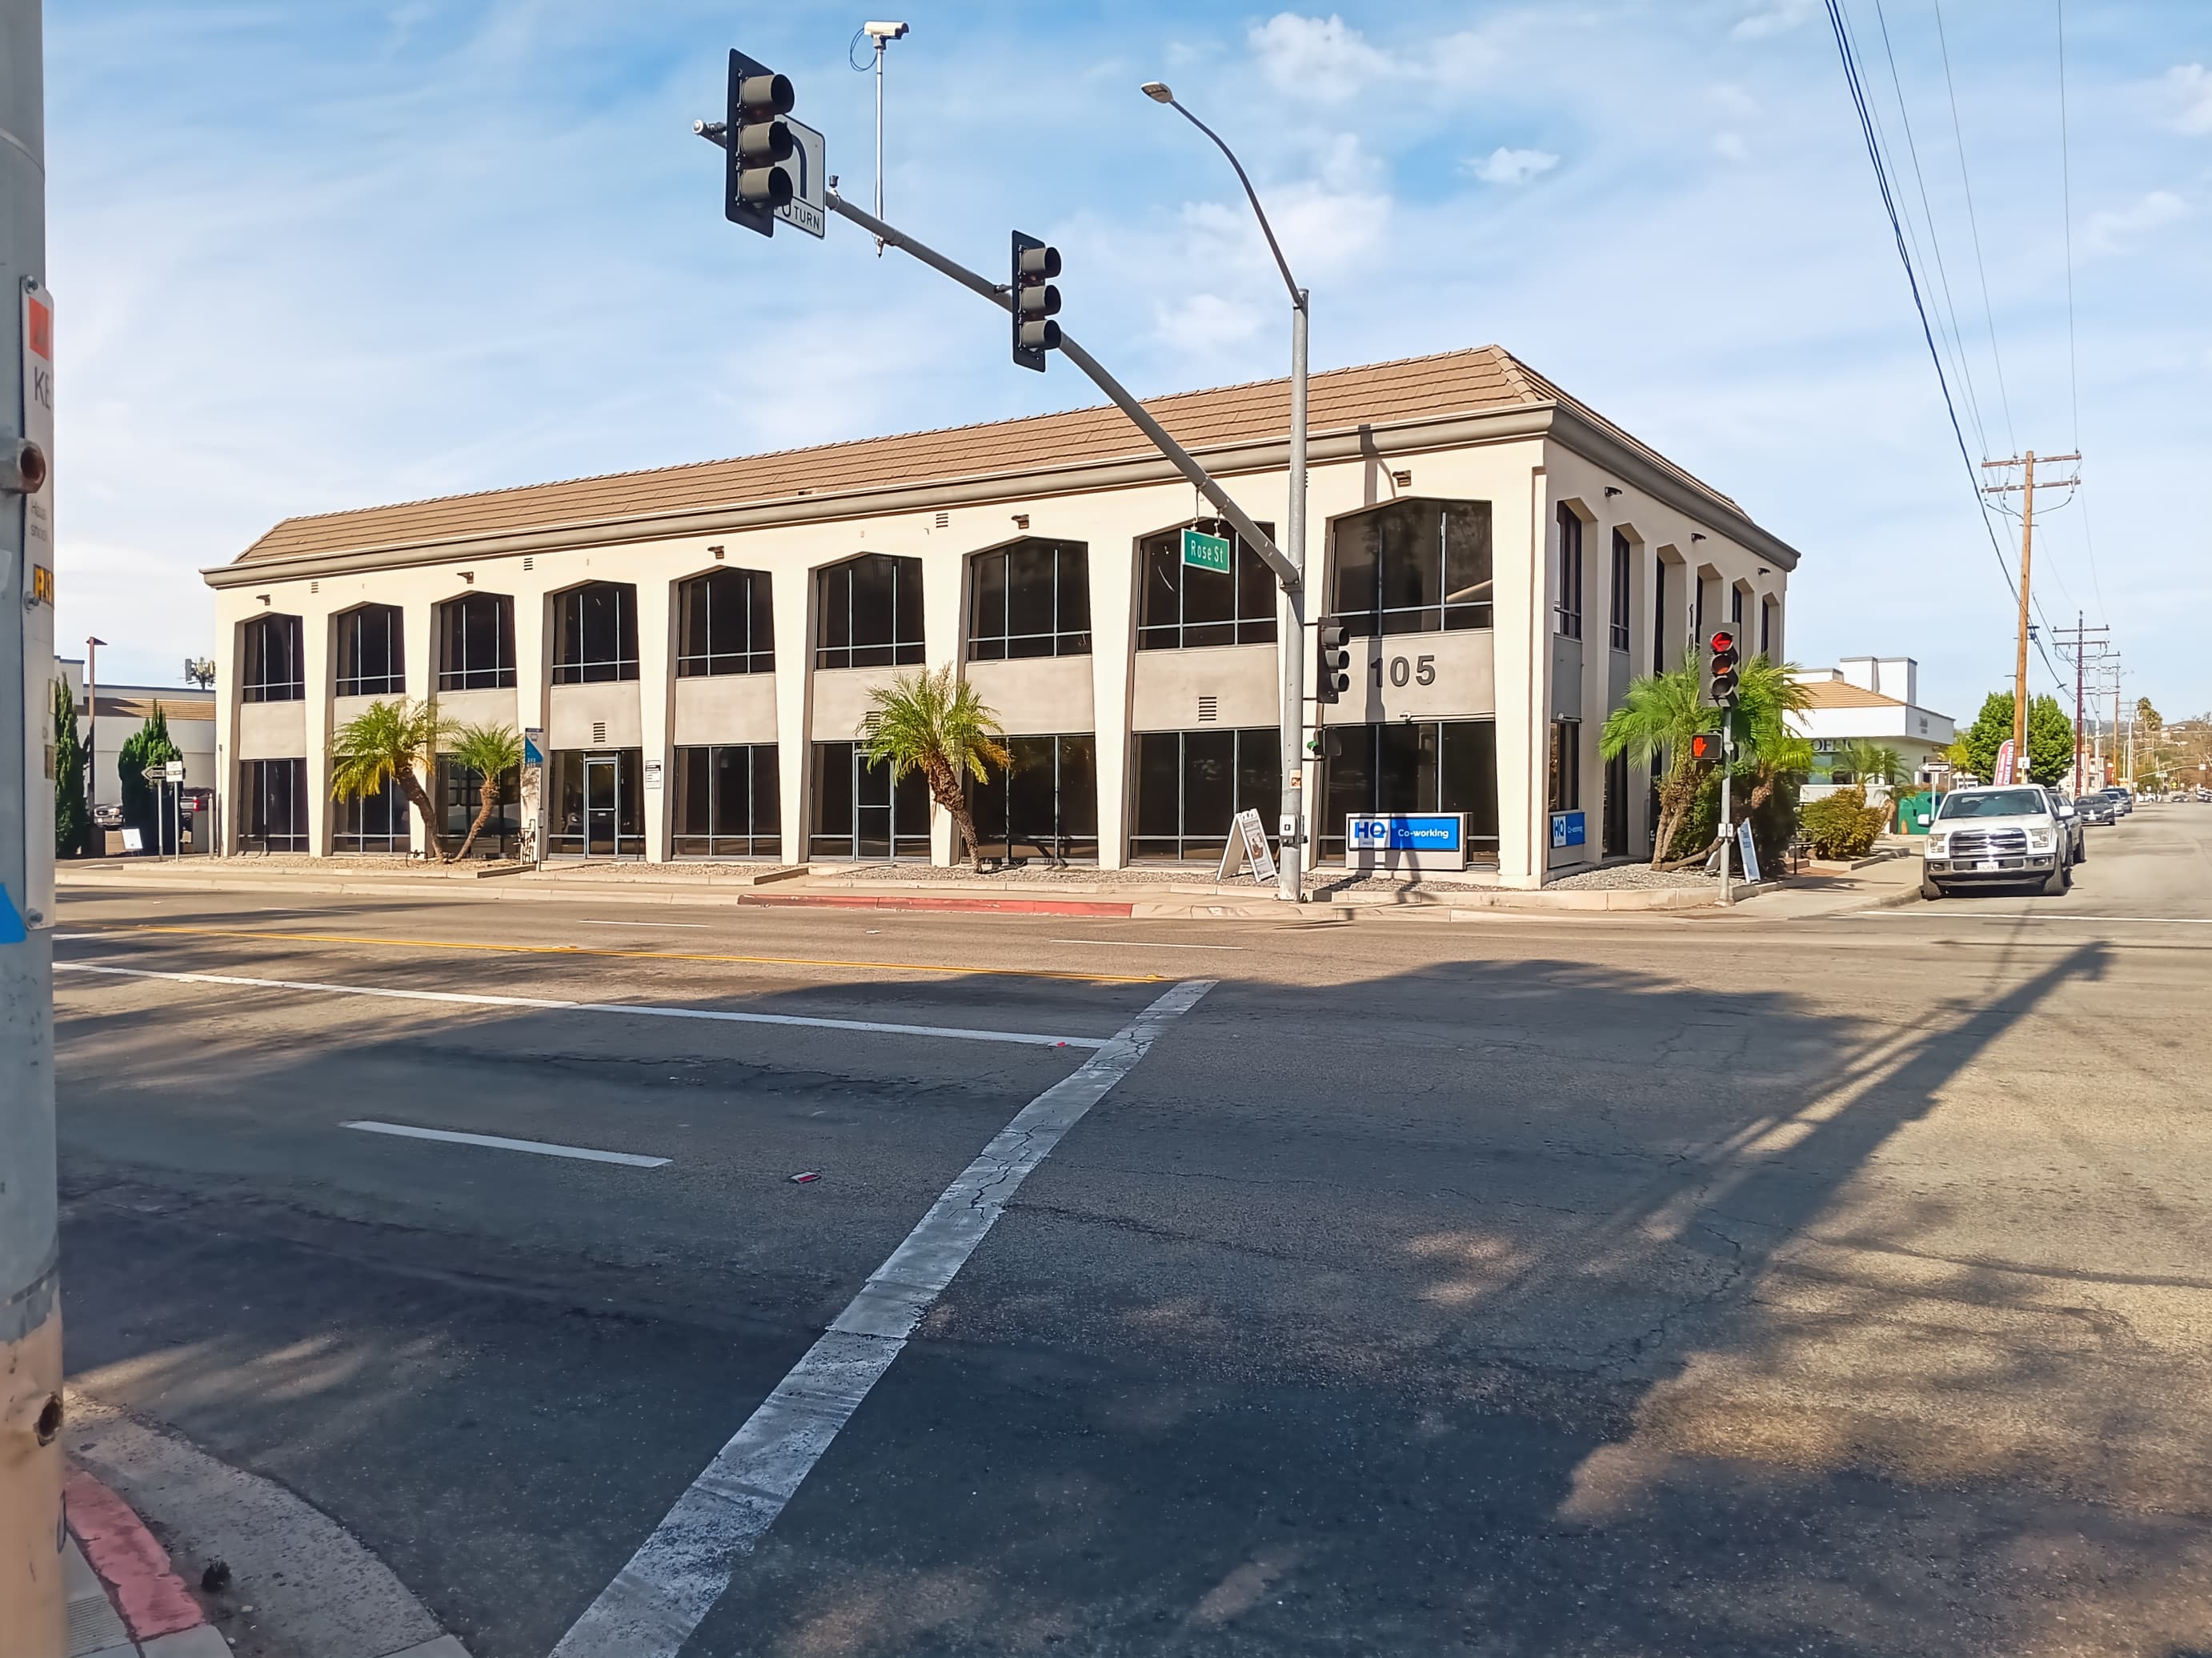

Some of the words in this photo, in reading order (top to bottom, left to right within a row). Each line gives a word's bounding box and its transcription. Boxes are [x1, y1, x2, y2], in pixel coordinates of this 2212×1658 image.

[794, 206, 819, 230] TURN
[1191, 539, 1212, 561] Rose
[1214, 546, 1224, 563] St
[1370, 655, 1436, 687] 105
[1354, 821, 1386, 839] HQ
[1397, 828, 1449, 839] Co-working
[1554, 819, 1565, 838] HQ
